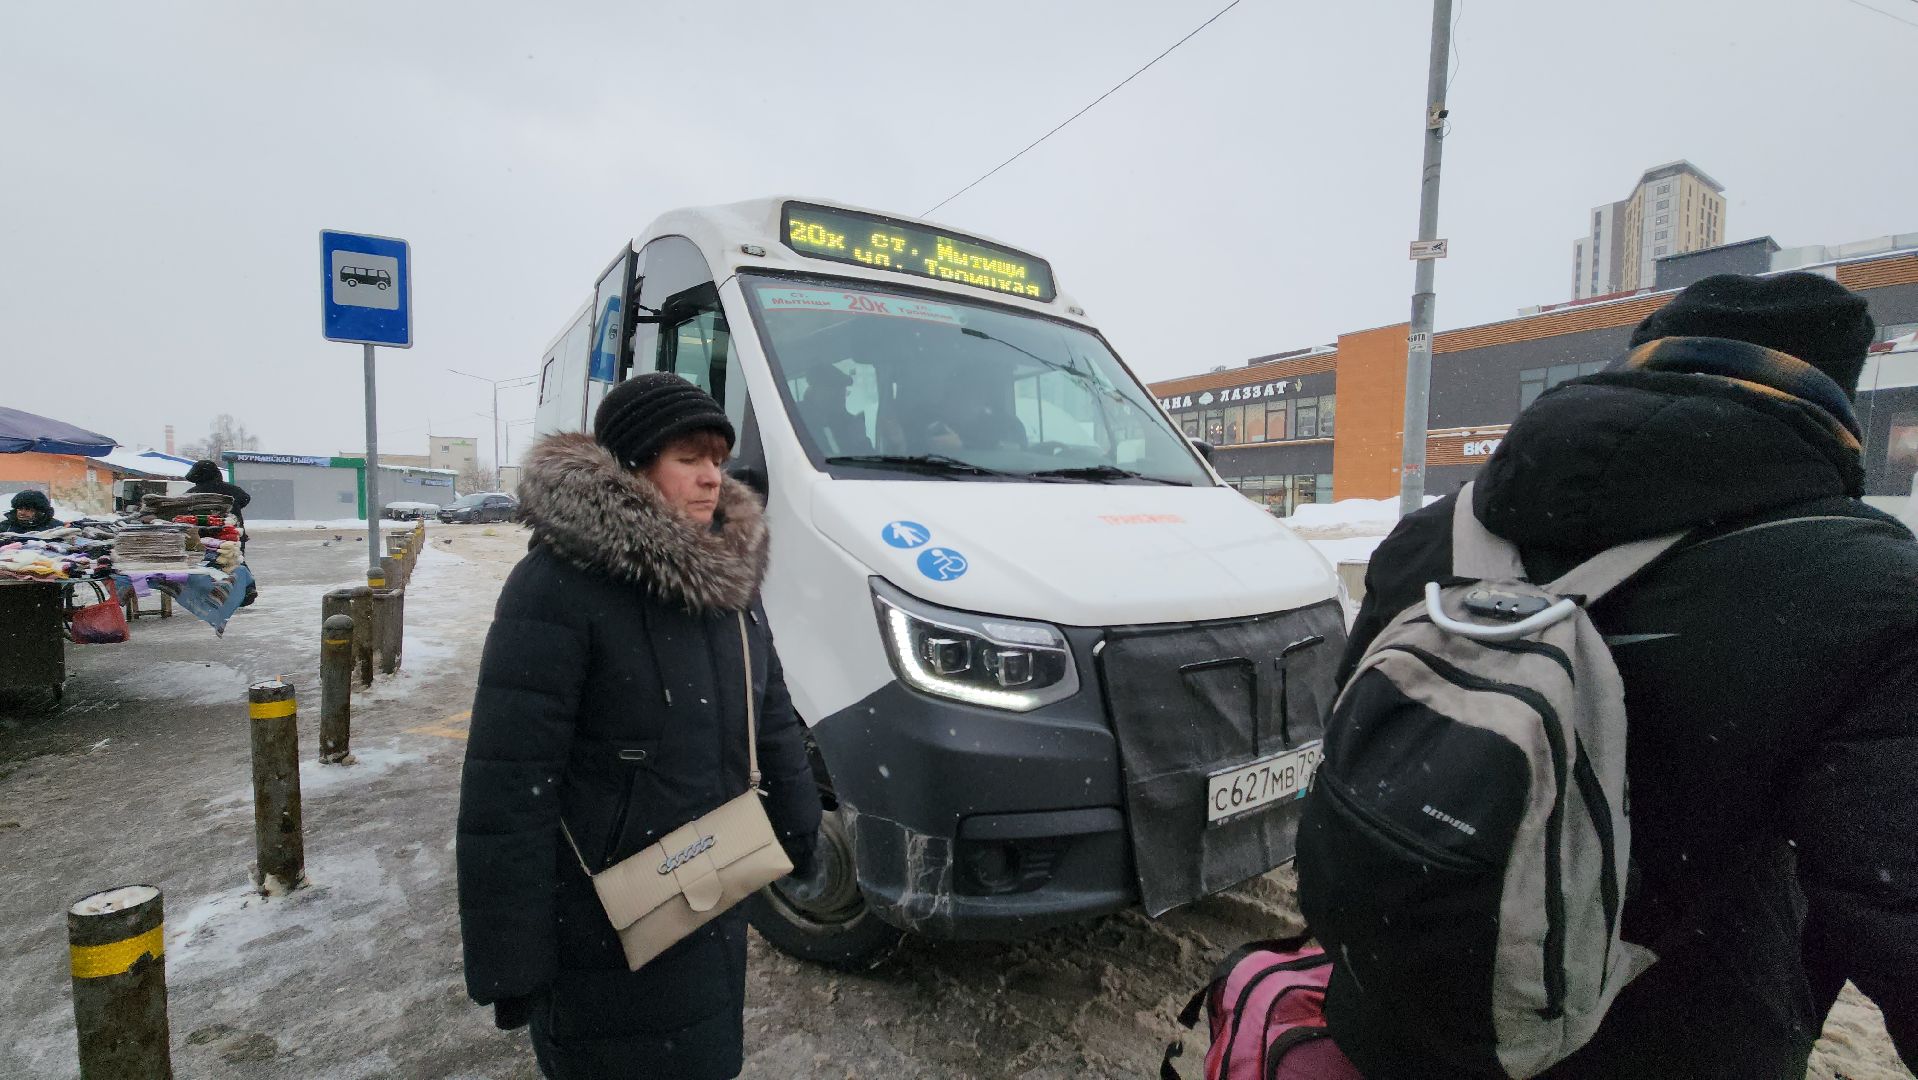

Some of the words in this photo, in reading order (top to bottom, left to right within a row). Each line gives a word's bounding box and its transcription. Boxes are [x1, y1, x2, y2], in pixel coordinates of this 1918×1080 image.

[871, 233, 919, 257] ст.
[936, 243, 1025, 279] Мытищи
[1157, 395, 1192, 412] АНА
[1220, 381, 1289, 403] ЛАЗЗАТ
[237, 454, 291, 463] МУРМАНСКАЯ
[1463, 438, 1502, 456] ВКУ
